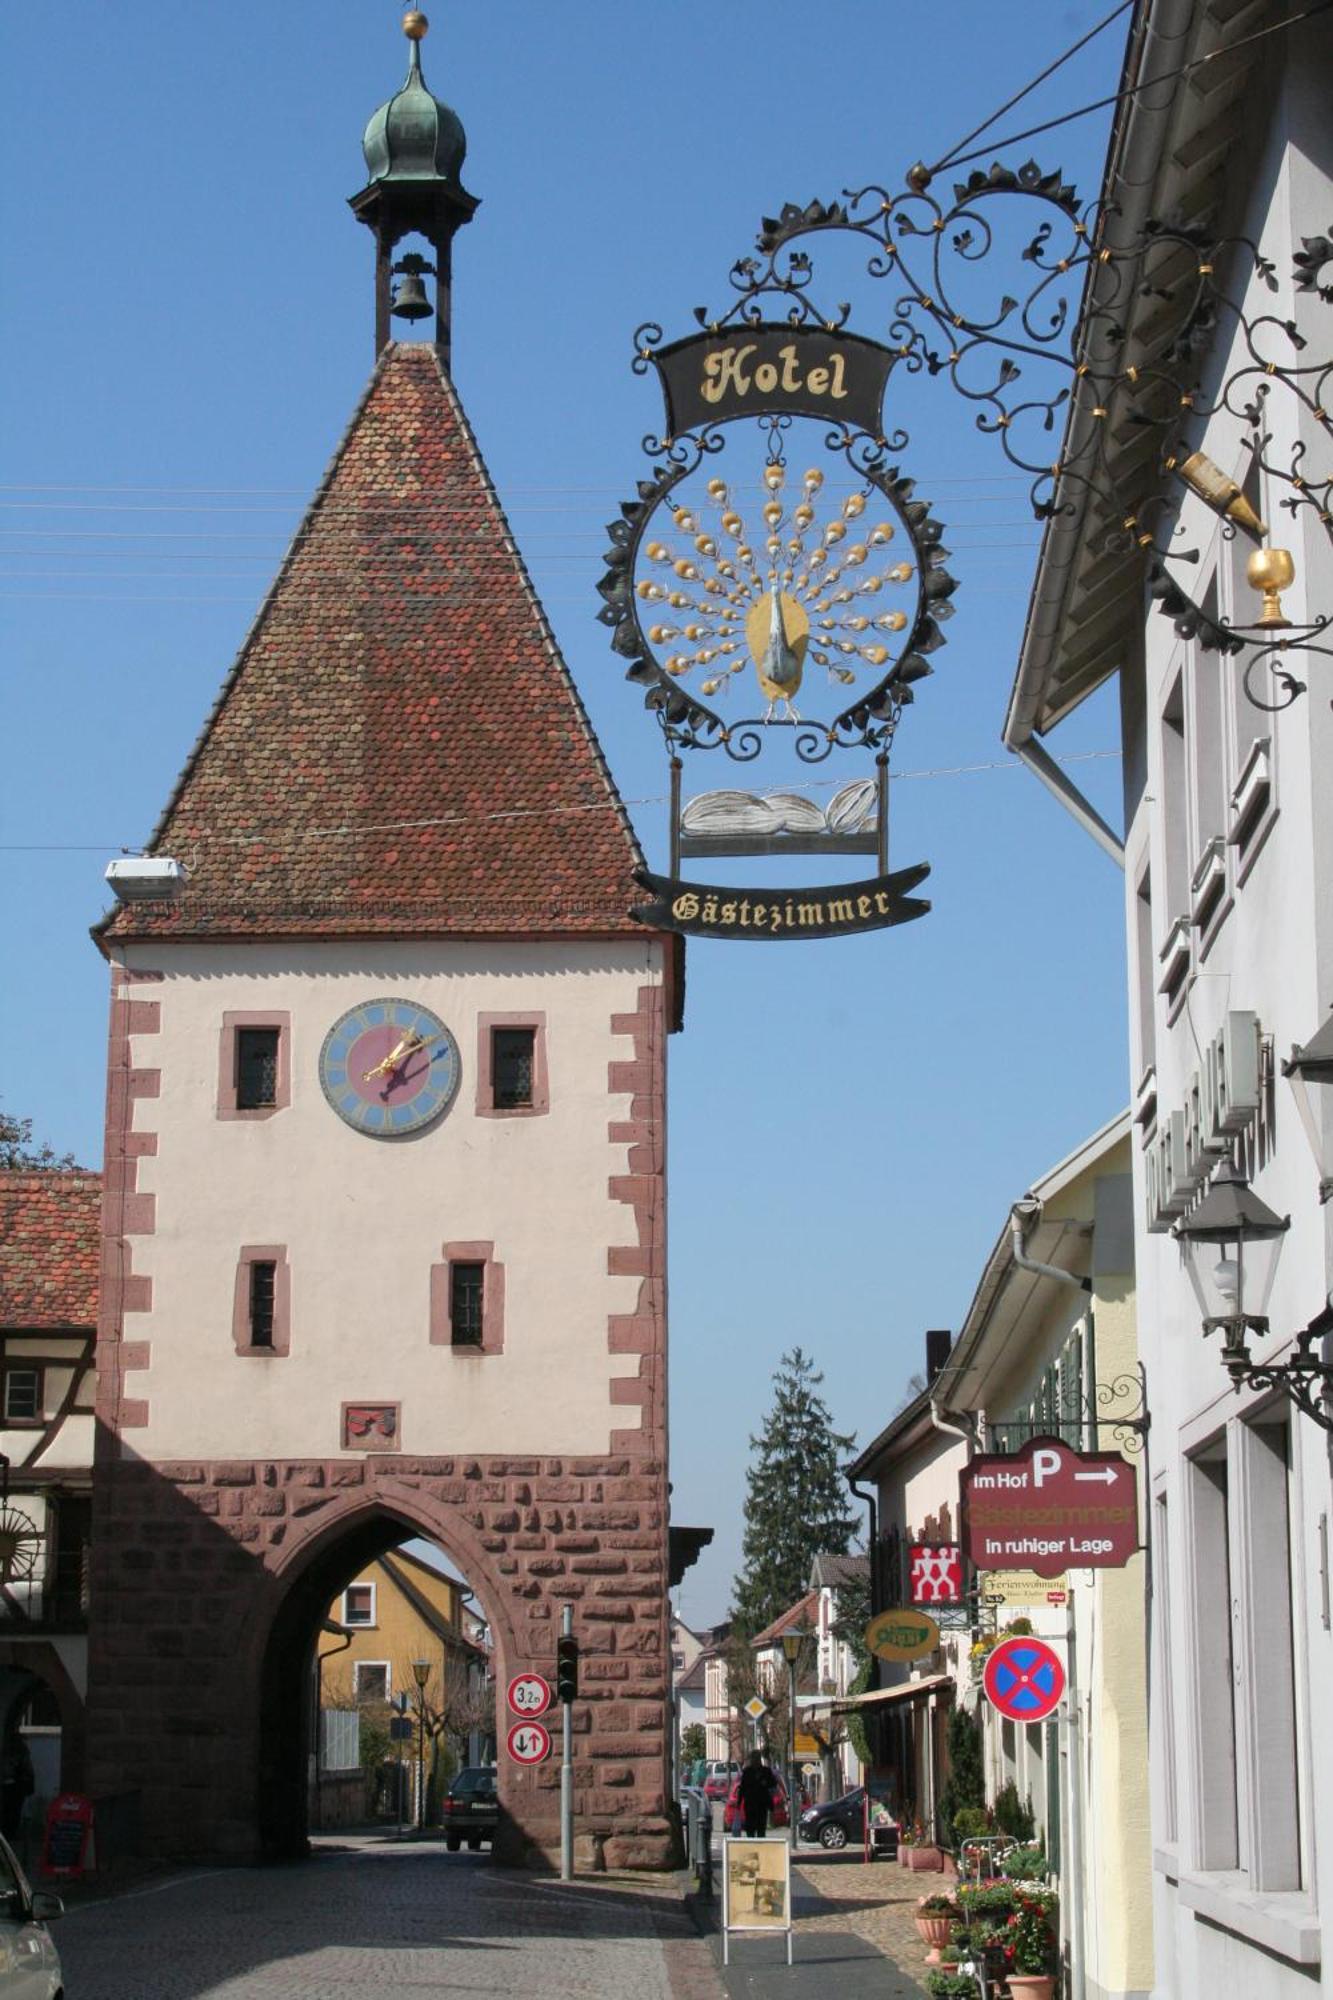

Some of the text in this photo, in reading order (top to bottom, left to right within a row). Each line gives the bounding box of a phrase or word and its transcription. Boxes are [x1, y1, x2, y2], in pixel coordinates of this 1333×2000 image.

[701, 345, 848, 402] Hotel
[672, 891, 889, 932] Gästezimmer
[998, 1473, 1028, 1488] Hof
[1033, 1450, 1061, 1487] P
[986, 1537, 1113, 1555] in ruhiger Lage
